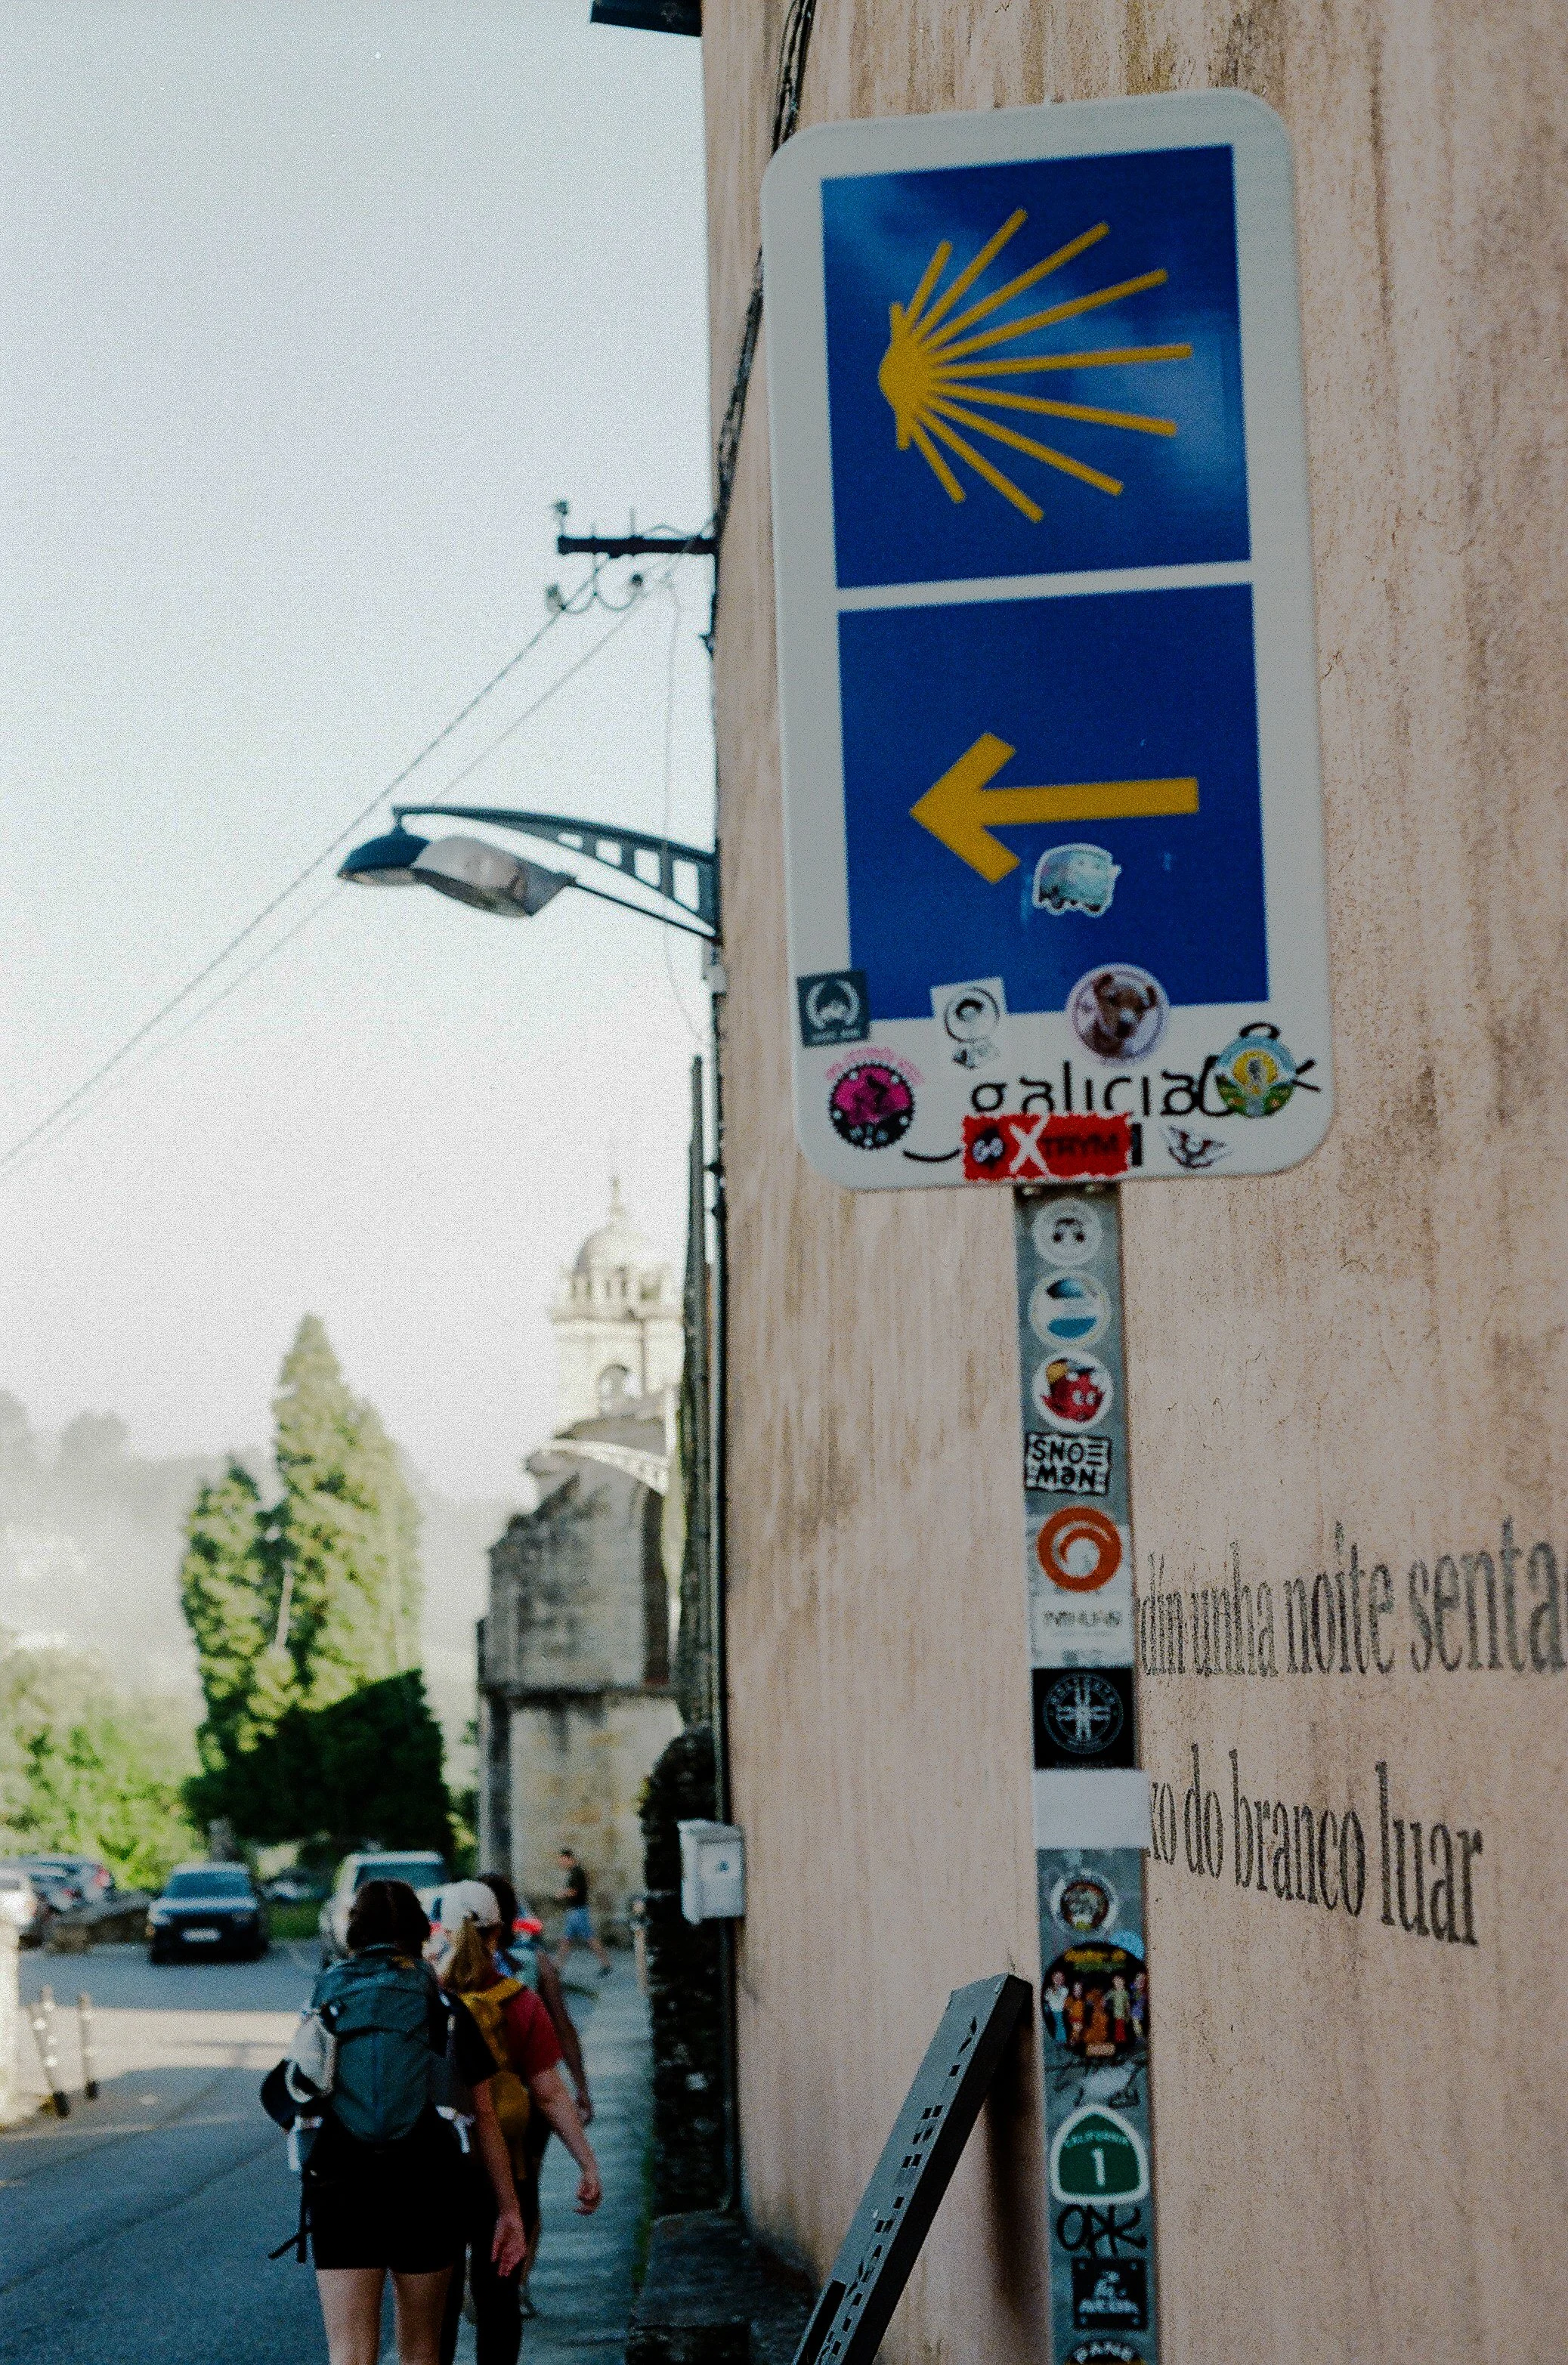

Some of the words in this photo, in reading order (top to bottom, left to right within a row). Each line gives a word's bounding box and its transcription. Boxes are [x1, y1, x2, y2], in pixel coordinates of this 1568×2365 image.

[1191, 1540, 1279, 1677] unha
[1284, 1519, 1396, 1674] noite
[1184, 1742, 1224, 1878] do
[1229, 1748, 1367, 1917] branco
[1375, 1761, 1484, 1946] luar
[1091, 2147, 1106, 2188] 1
